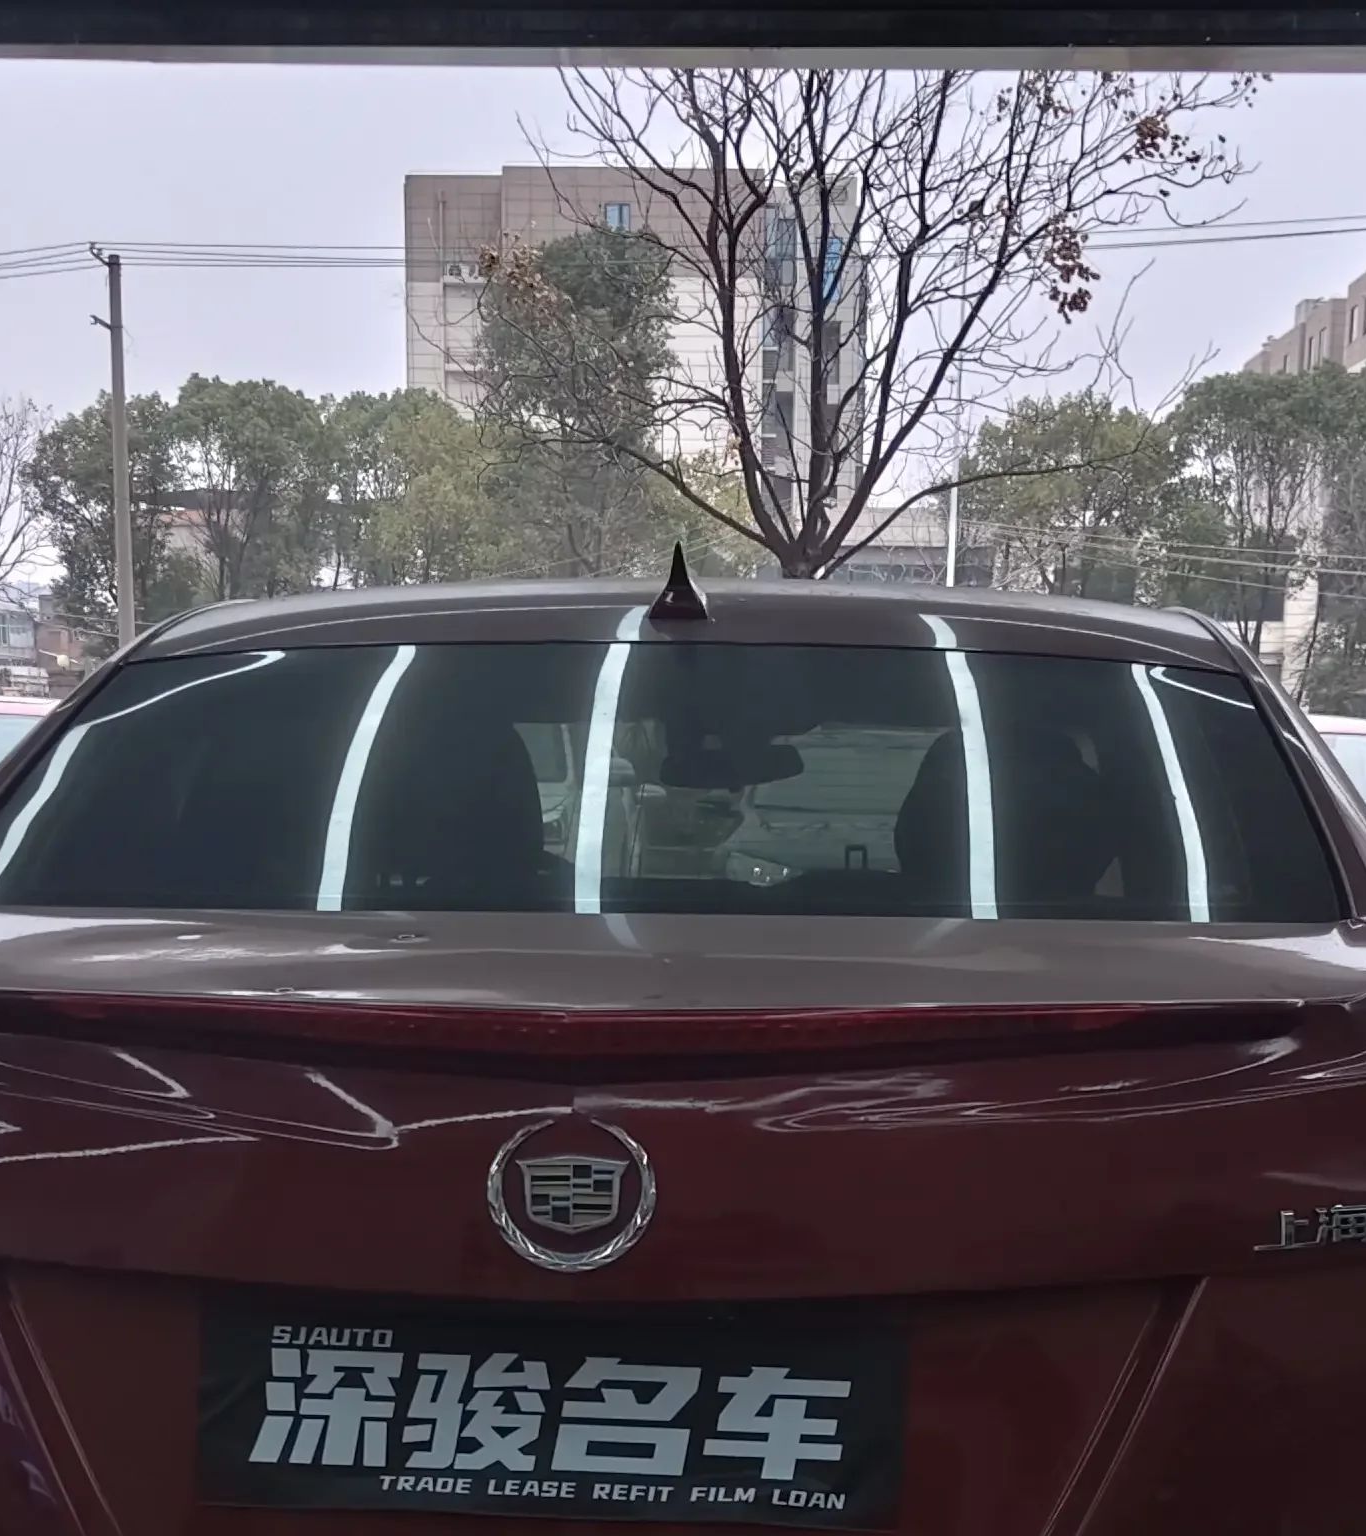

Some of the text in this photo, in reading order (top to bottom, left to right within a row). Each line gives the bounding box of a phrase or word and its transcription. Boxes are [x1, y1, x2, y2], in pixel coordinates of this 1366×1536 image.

[271, 1325, 393, 1348] SJAUTO
[248, 1347, 852, 1481] 深骏名车
[379, 1474, 846, 1510] TRADE LEASE REFIT FILM LOAN
